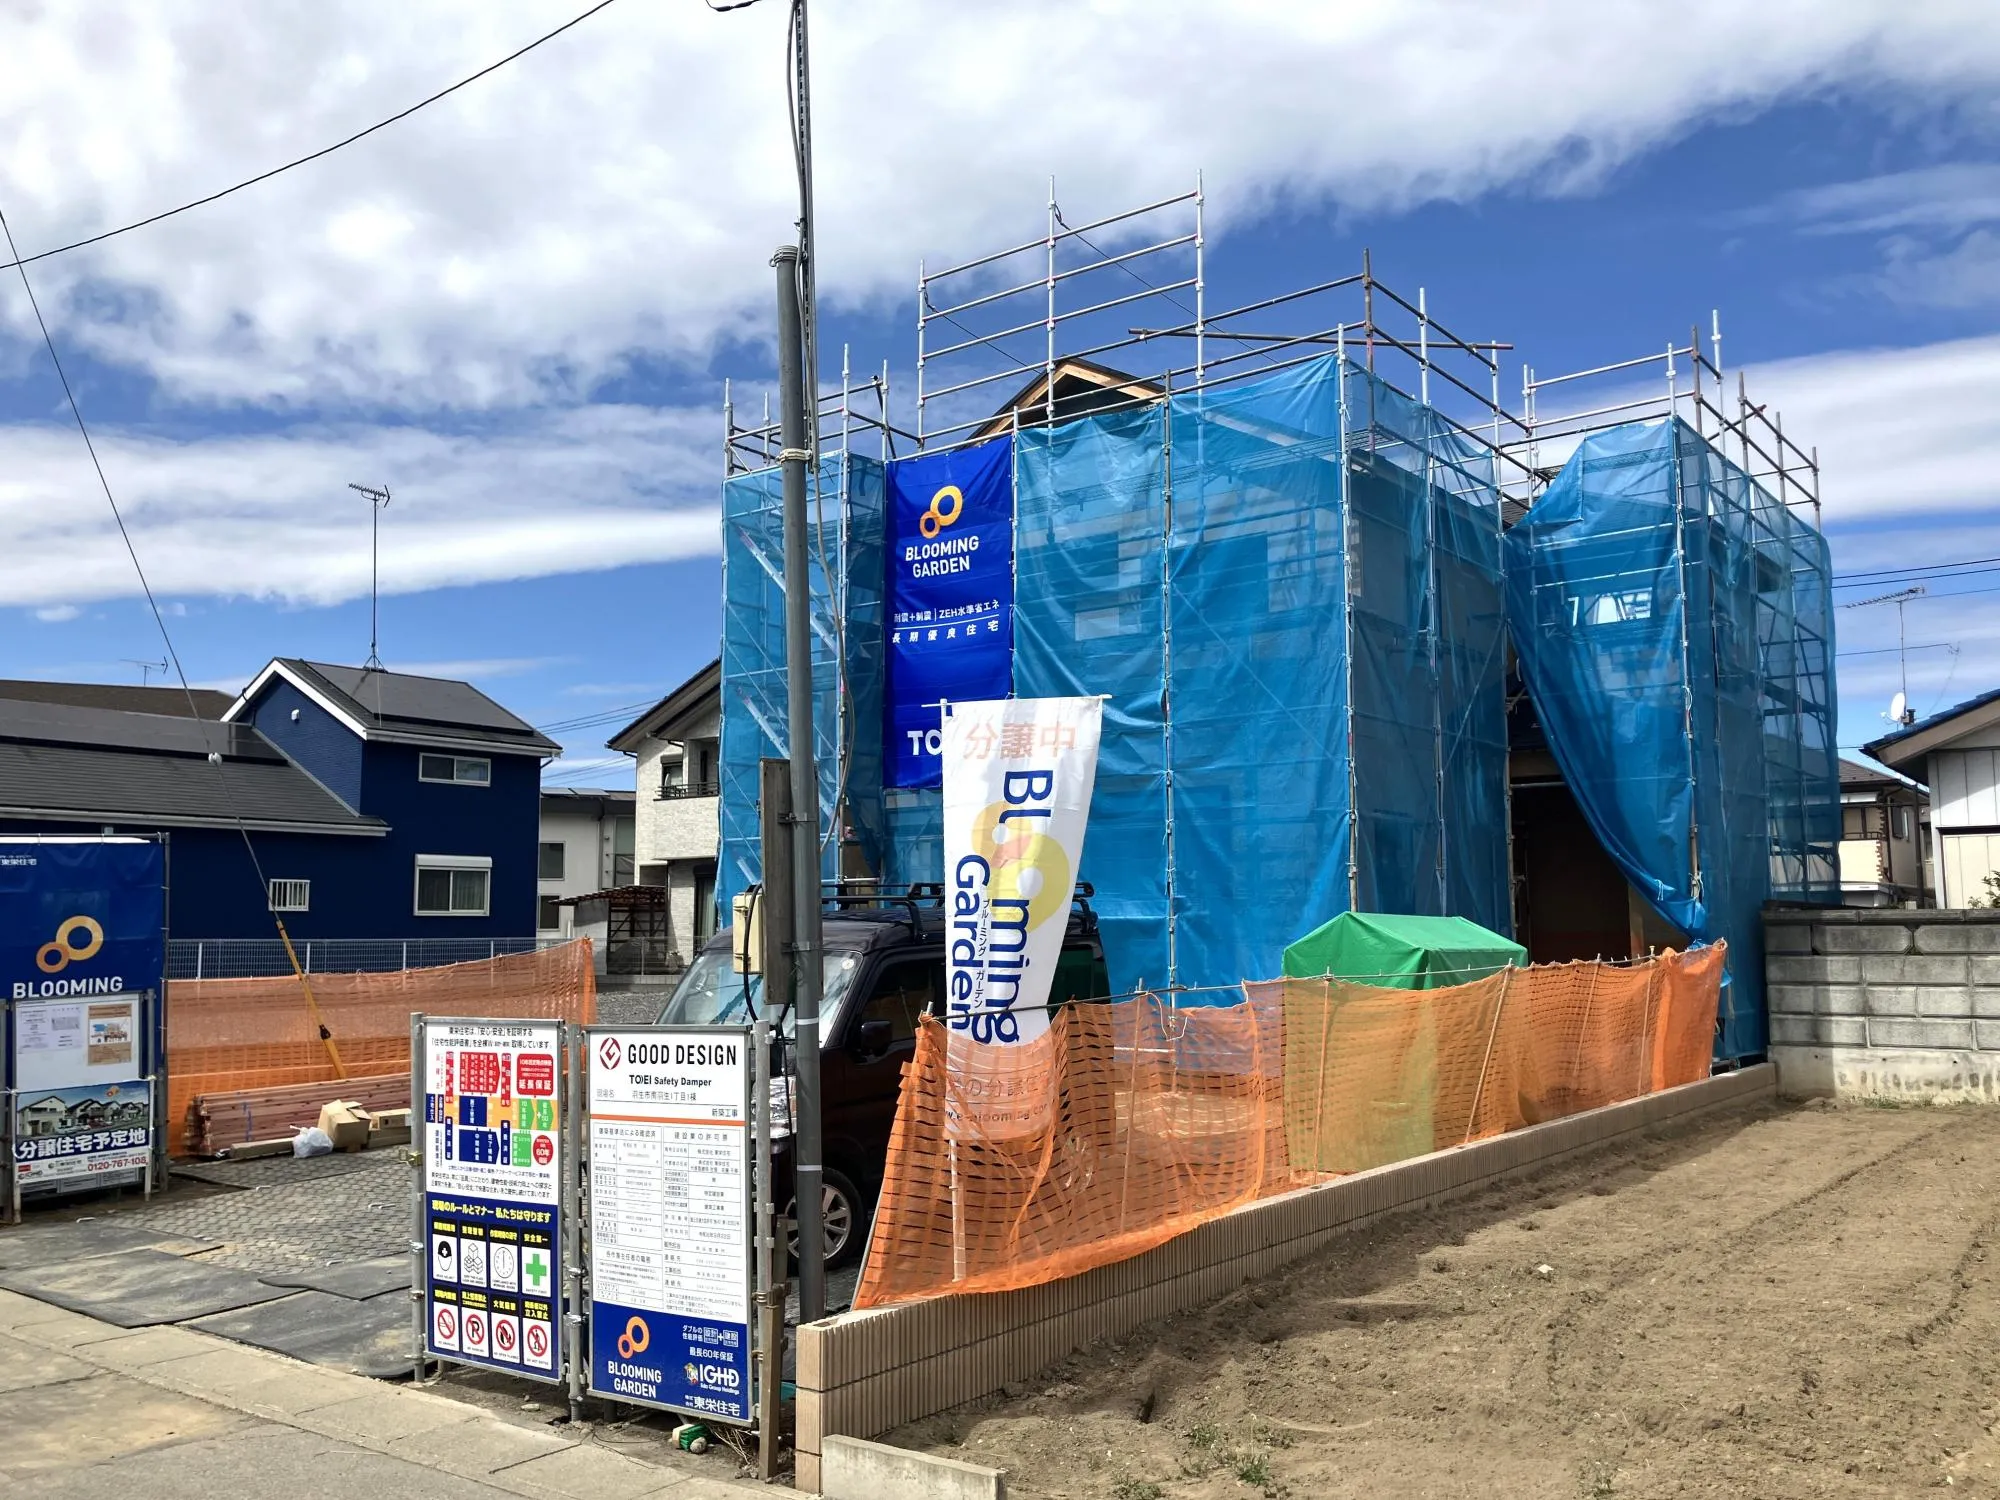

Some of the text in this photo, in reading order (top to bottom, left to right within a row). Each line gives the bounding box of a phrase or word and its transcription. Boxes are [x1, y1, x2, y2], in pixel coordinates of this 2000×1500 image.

[905, 536, 979, 561] BLOOMING
[913, 555, 970, 578] GARDEN
[892, 620, 999, 643] 長期優良住宅
[963, 721, 1076, 760] 分譲中
[978, 898, 990, 957] ブルーミング
[951, 854, 991, 1030] Garden
[13, 976, 123, 999] BLOOMING
[974, 971, 985, 1009] ガーデン
[628, 1043, 737, 1066] GOOD DESIGN
[654, 1076, 679, 1088] Safety
[681, 1077, 712, 1088] Damper
[20, 1127, 146, 1159] 分譲住宅予定地
[495, 1207, 551, 1223] 私たちは守ります
[608, 1360, 662, 1384] BLOOMING
[614, 1377, 657, 1399] GARDEN
[694, 1396, 741, 1417] 東栄住宅
